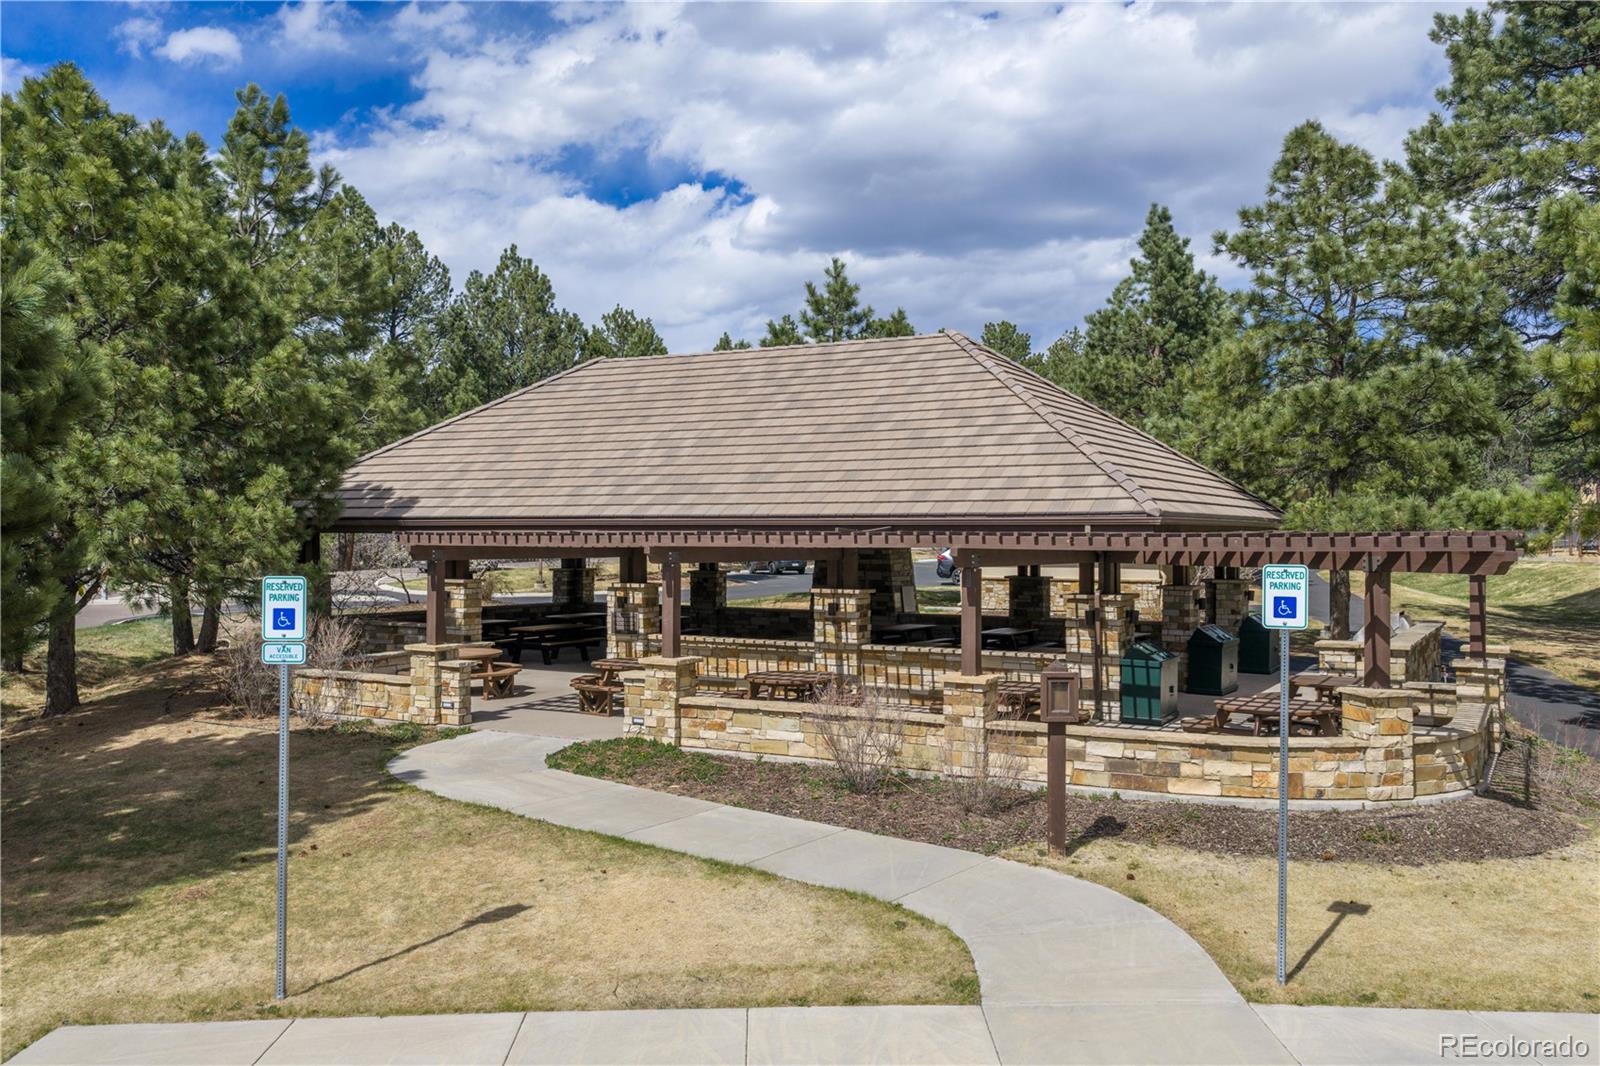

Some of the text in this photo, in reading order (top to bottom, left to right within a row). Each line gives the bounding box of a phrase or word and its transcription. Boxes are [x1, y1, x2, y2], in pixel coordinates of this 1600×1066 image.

[1266, 570, 1305, 580] RESERVED
[266, 582, 303, 591] RESERVED
[1269, 581, 1302, 591] PARKING
[269, 593, 300, 602] PARKING
